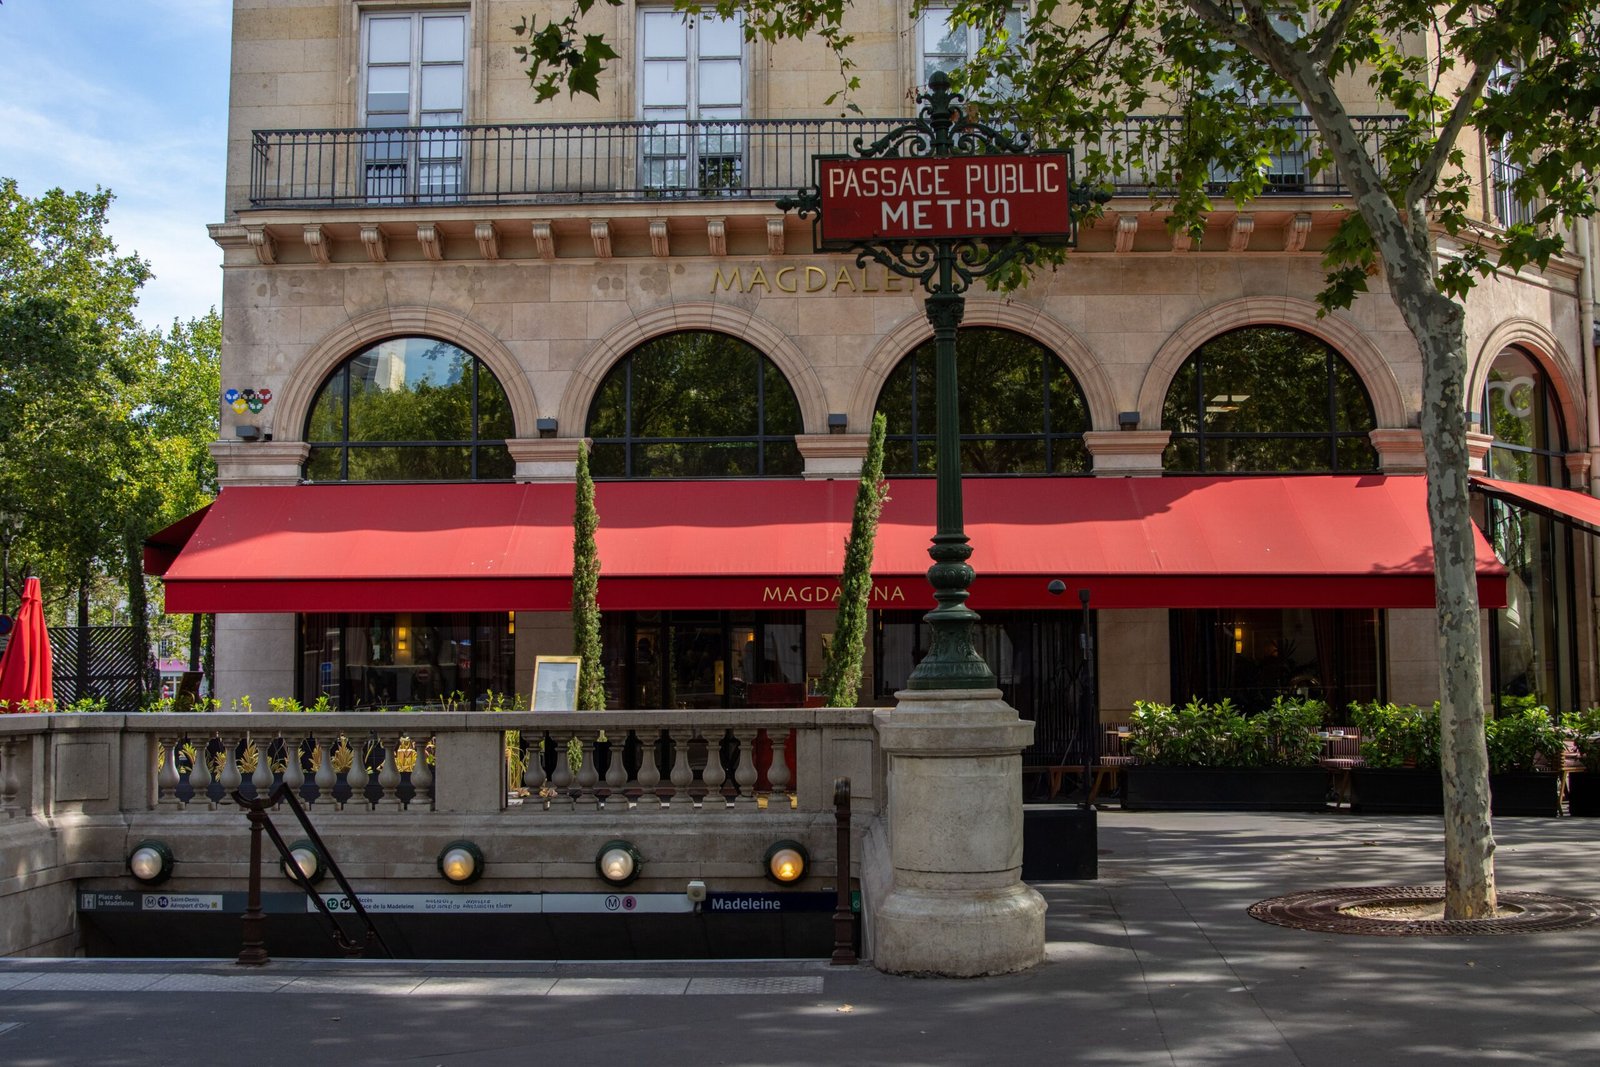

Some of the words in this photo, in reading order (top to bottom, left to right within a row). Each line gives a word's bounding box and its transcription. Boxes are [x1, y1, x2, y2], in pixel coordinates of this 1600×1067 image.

[829, 164, 950, 198] PASSAGE
[965, 162, 1060, 195] PUBLIC
[881, 198, 1010, 231] METRO
[710, 265, 963, 293] MAGDALE
[762, 585, 905, 602] MAGDANA
[158, 898, 167, 906] 14
[328, 900, 337, 908] 12
[341, 900, 350, 908] 14
[711, 897, 781, 910] Madeleine
